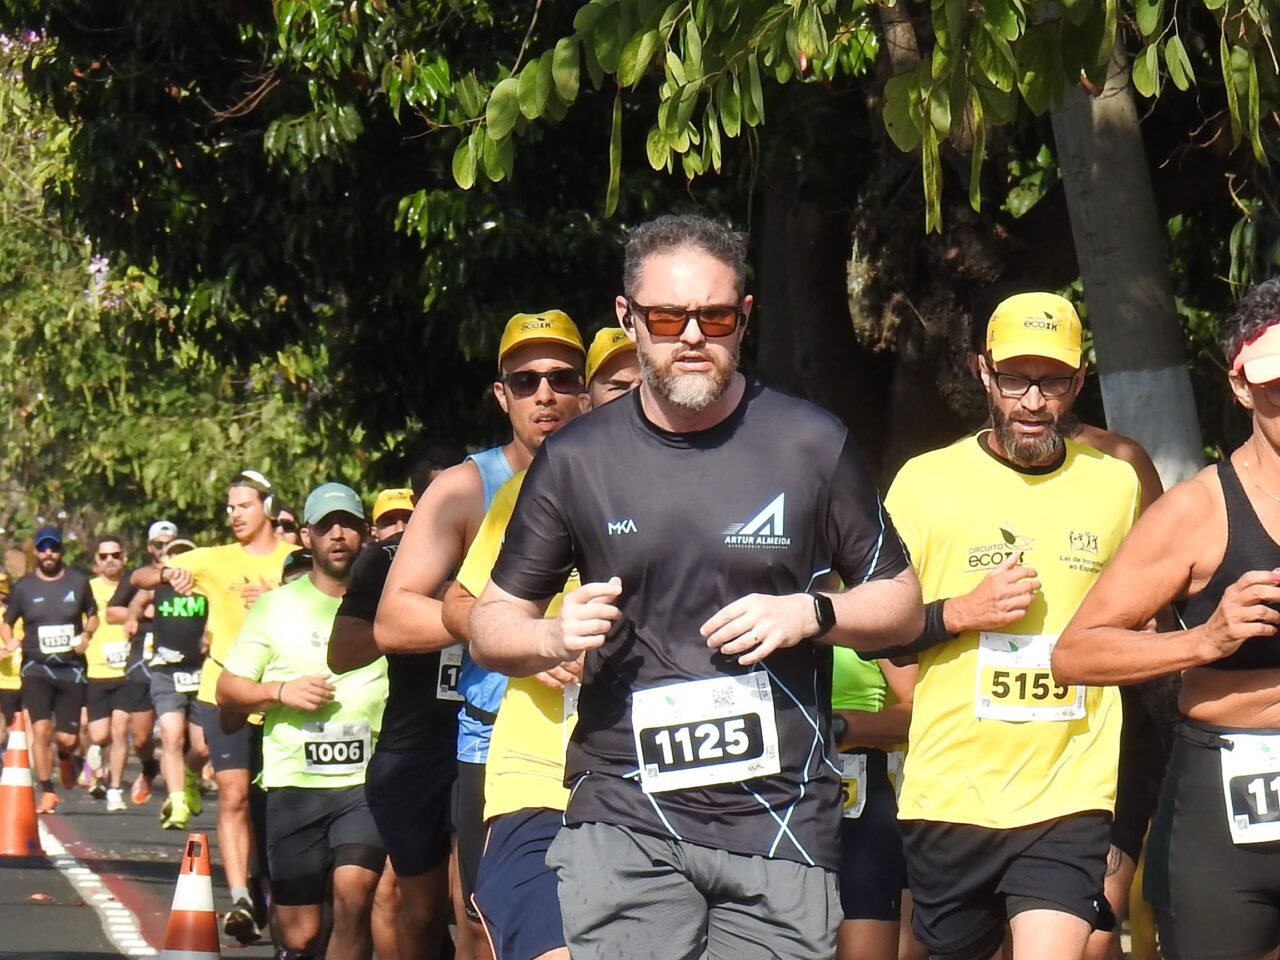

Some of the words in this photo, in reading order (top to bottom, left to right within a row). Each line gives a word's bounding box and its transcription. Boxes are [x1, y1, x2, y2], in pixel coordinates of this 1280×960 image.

[724, 536, 754, 544] ARTUR
[756, 537, 791, 545] ALMEIDA
[969, 544, 1003, 554] CIRCUITO
[655, 719, 749, 765] 1125
[308, 742, 360, 762] 1006
